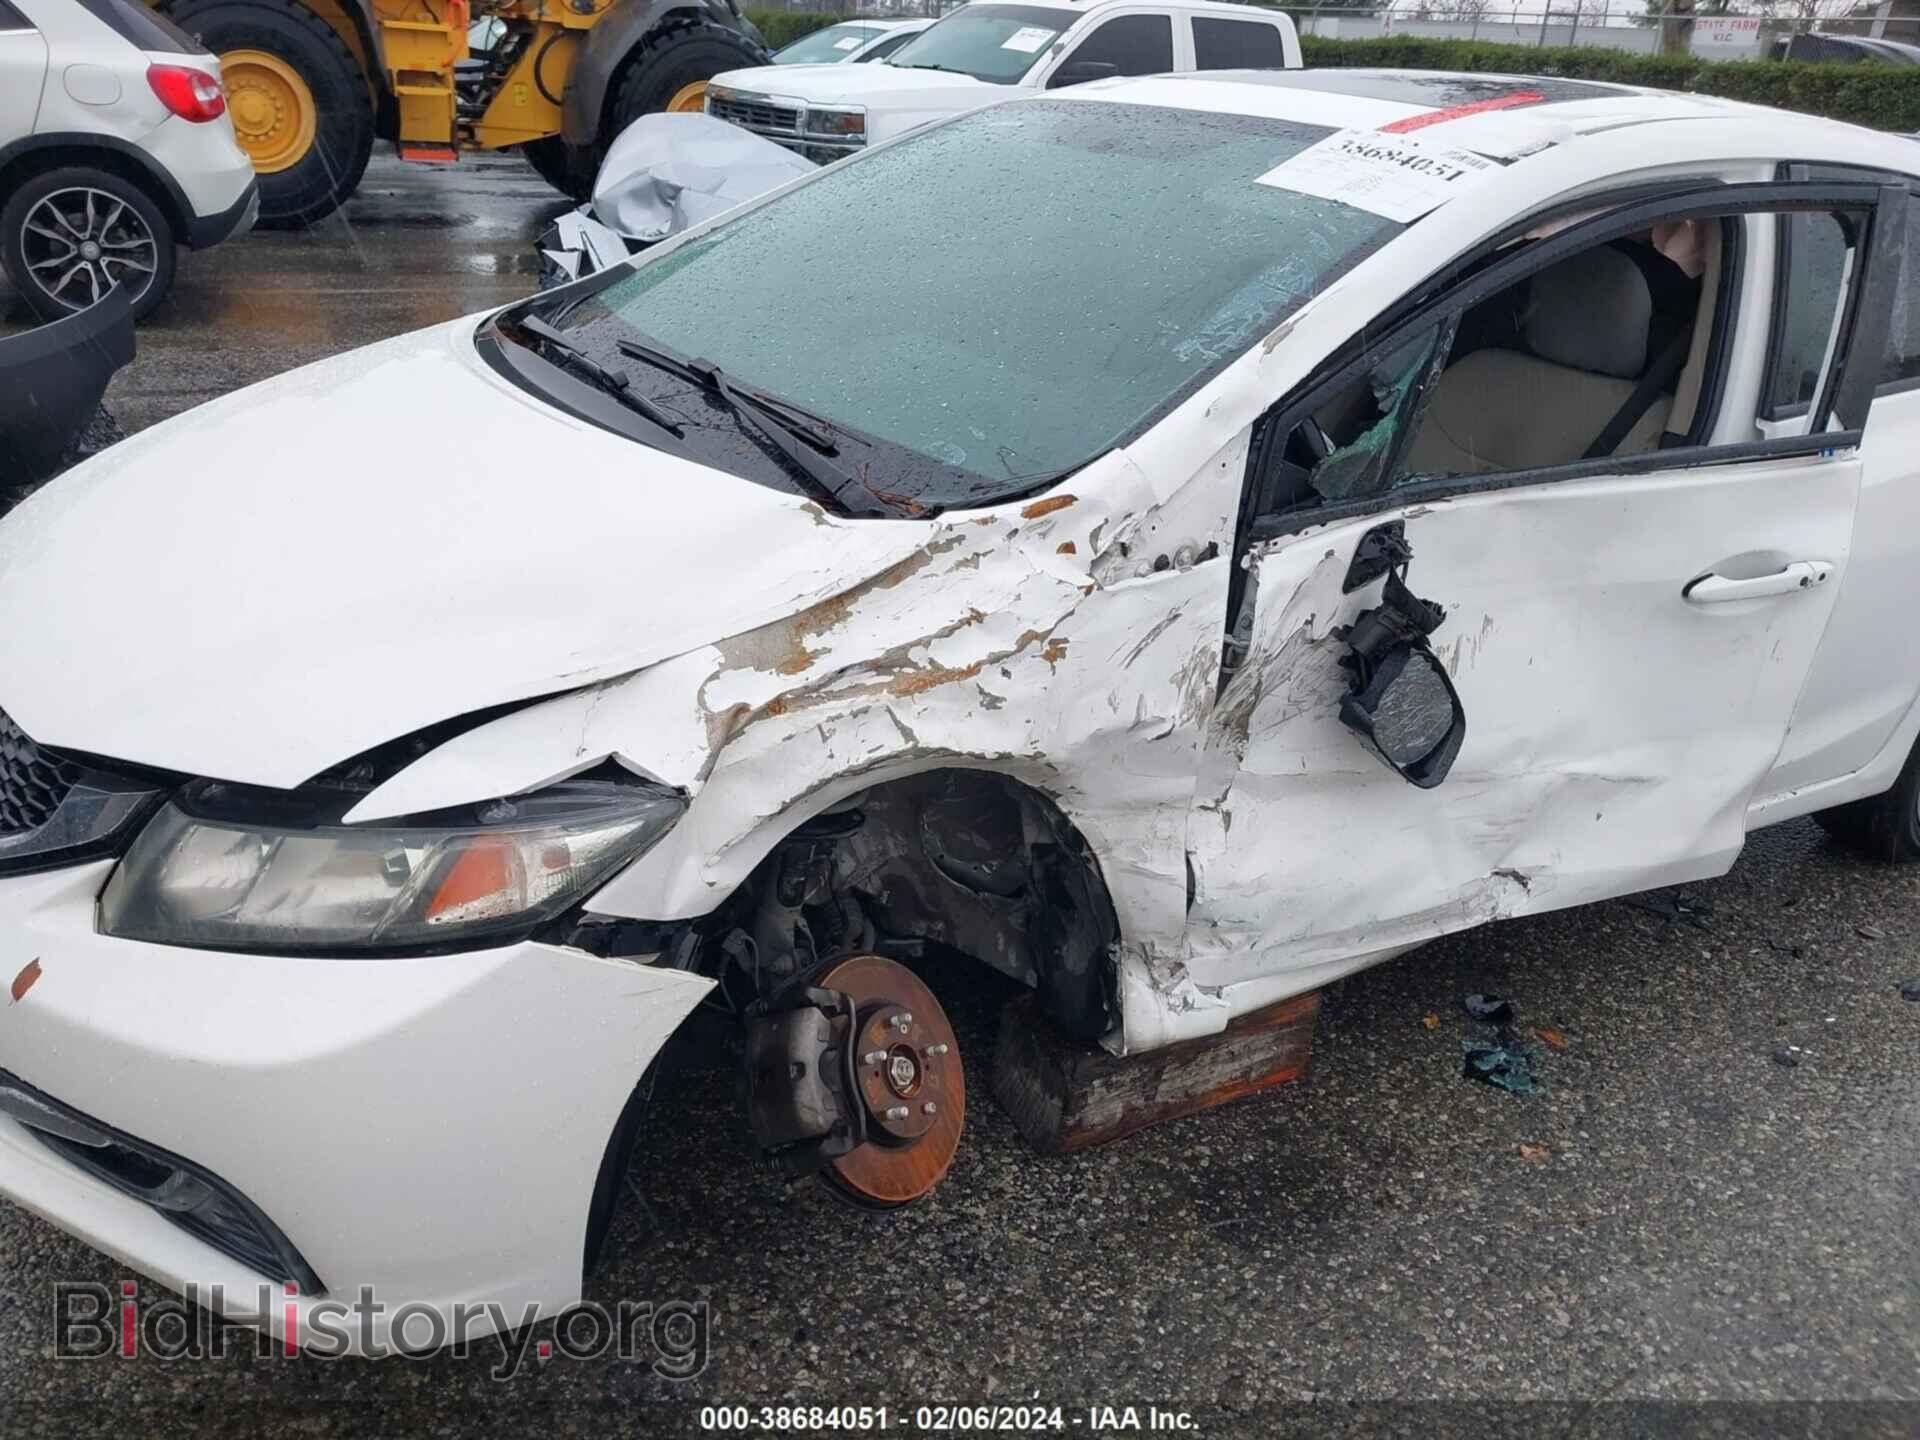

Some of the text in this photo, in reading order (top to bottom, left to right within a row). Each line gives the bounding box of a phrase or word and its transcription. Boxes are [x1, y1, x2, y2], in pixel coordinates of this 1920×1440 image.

[1696, 18, 1759, 31] STATE FARM
[1341, 139, 1466, 181] 38684051
